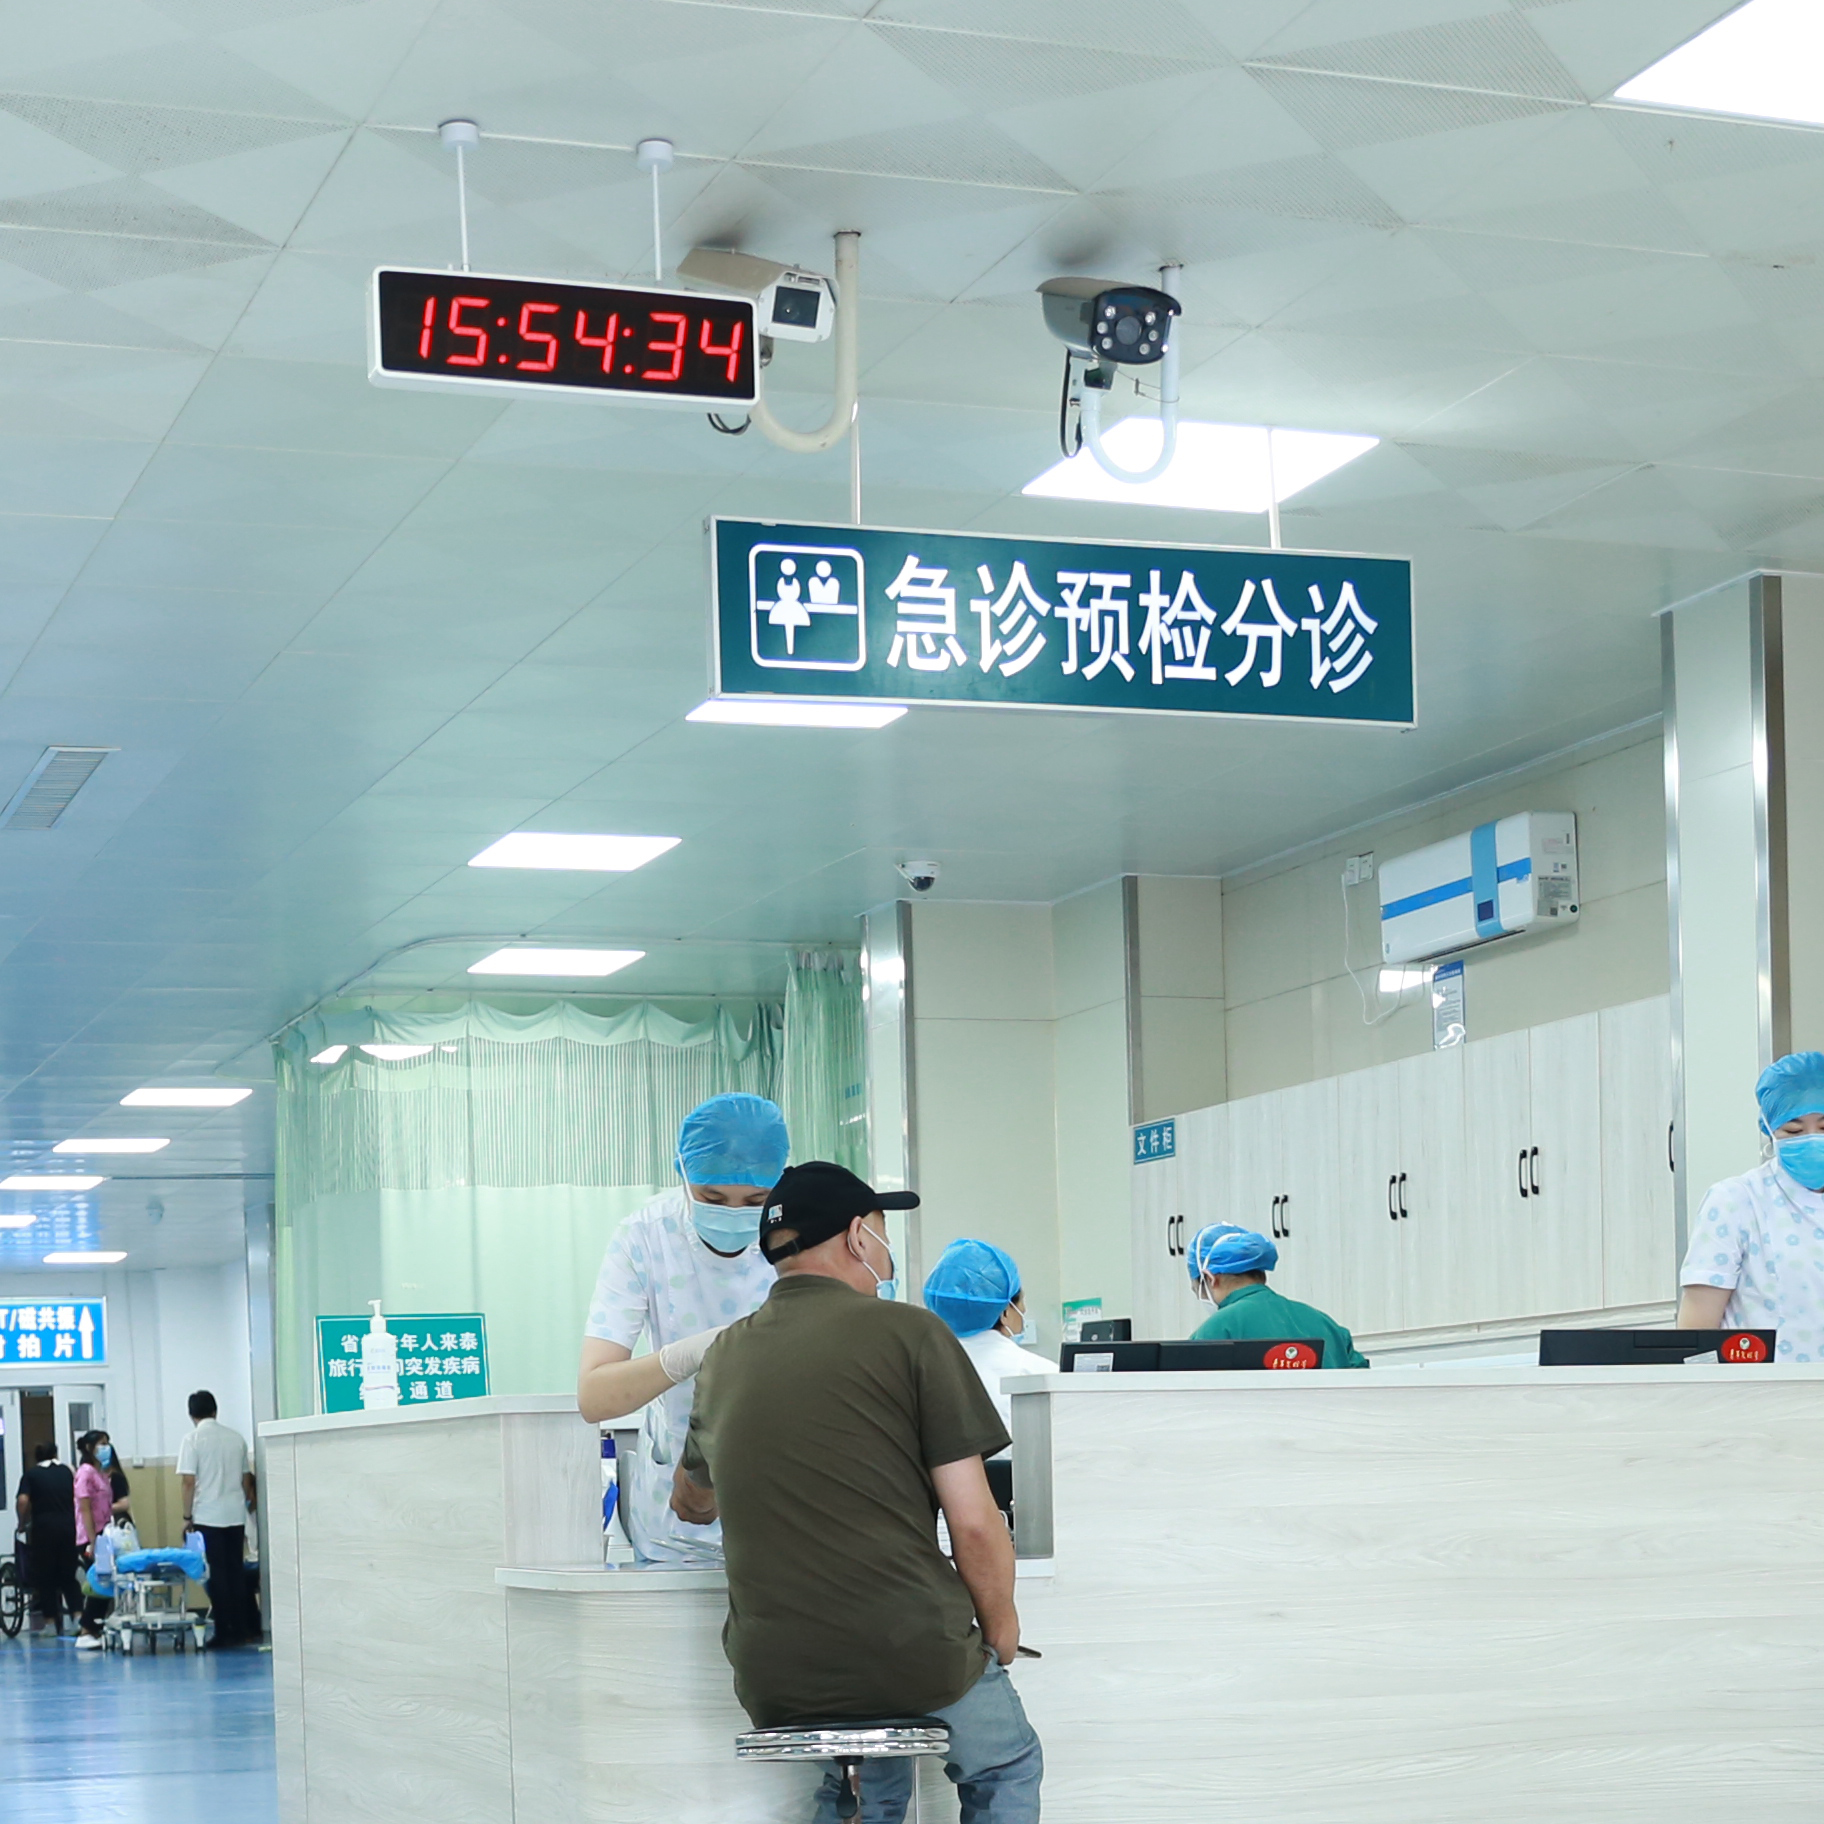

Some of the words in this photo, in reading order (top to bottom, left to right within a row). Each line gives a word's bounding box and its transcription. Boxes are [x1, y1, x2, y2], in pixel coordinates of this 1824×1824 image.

[418, 296, 744, 383] 15:54:34
[884, 554, 1378, 694] 急诊预检分诊
[1137, 1126, 1173, 1155] 文件柜
[341, 1332, 479, 1353] 省年人来泰
